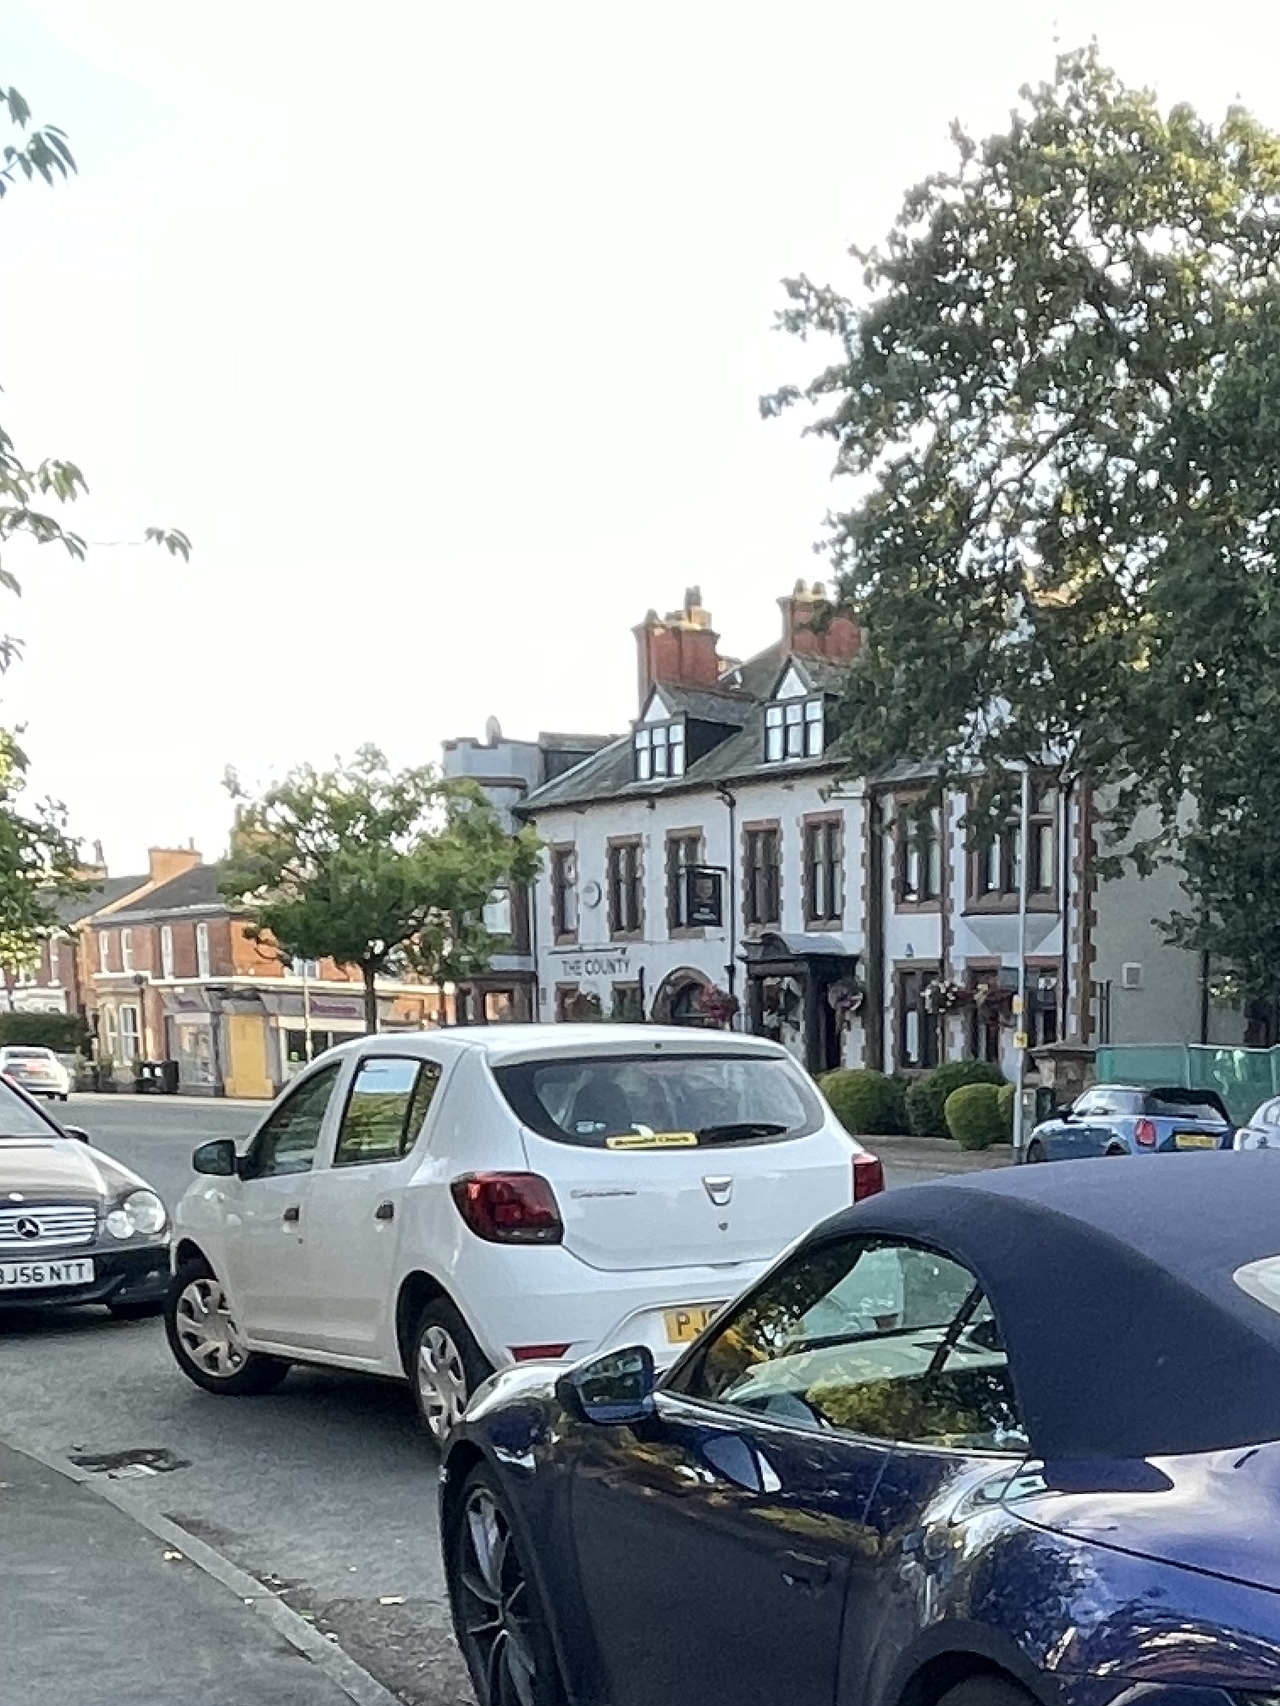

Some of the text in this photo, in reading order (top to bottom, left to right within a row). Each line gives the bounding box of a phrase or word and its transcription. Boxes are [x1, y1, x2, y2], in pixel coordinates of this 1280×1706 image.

[561, 957, 631, 977] THE COUNTY
[49, 1262, 86, 1282] NTT
